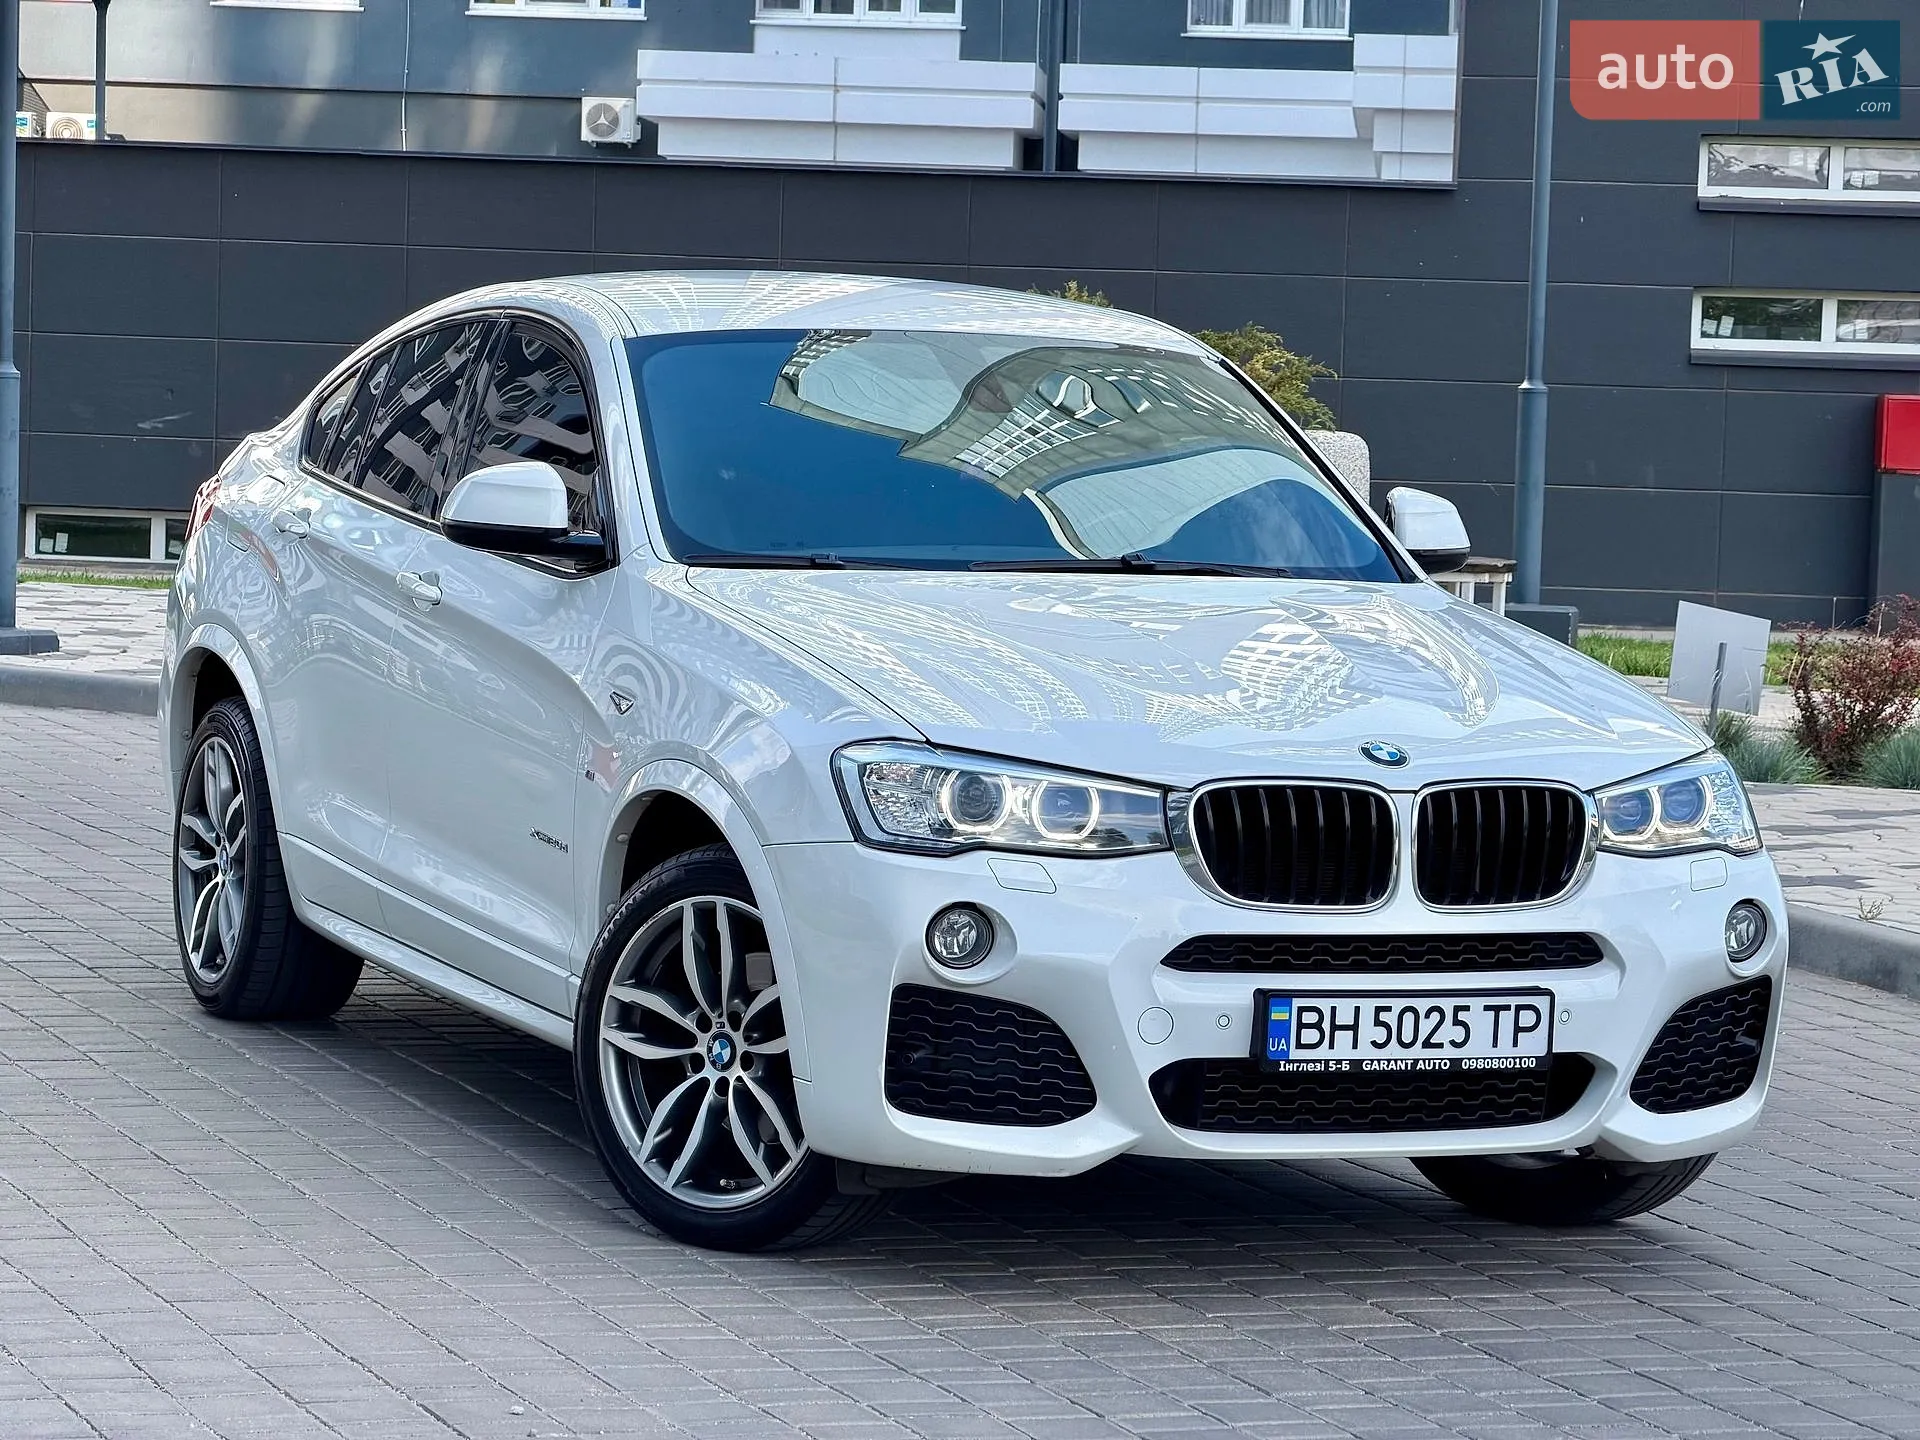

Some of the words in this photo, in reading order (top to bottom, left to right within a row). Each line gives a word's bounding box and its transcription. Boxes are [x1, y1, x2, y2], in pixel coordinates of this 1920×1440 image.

[1295, 1005, 1360, 1050] BH
[1370, 1005, 1471, 1050] 5025
[1483, 1003, 1541, 1049] TP
[1269, 1037, 1288, 1052] UA
[1279, 1061, 1325, 1072] Інглезі
[1328, 1061, 1350, 1071] 5-Б
[1362, 1060, 1414, 1071] GARANT
[1416, 1059, 1450, 1070] AUTO
[1462, 1058, 1536, 1070] 0980800100
